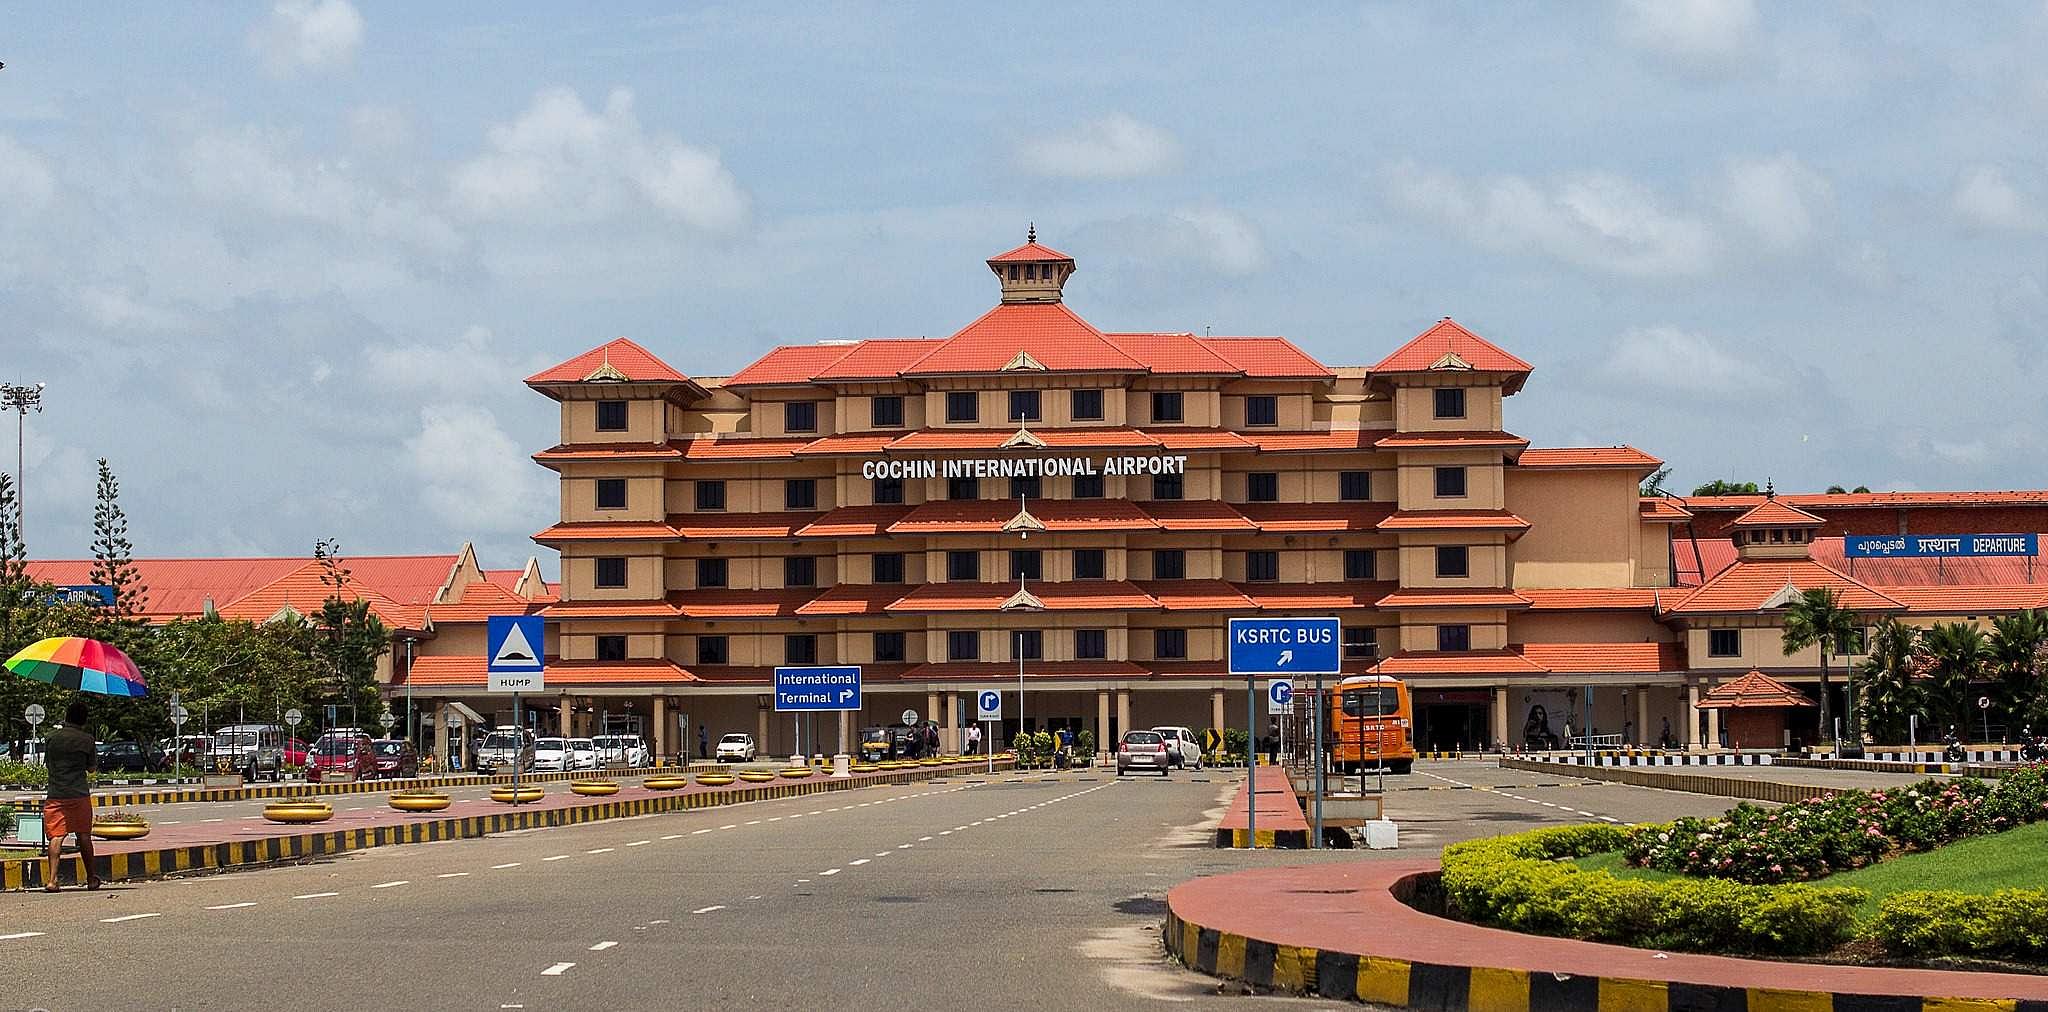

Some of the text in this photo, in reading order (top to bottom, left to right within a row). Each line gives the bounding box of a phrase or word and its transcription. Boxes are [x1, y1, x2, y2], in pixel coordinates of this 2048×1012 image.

[862, 455, 1187, 479] COCHIN INTERNATIONAL AIRPORT
[1918, 538, 1960, 553] प्रस्थान
[1973, 537, 2026, 553] DEPARTURE
[1237, 628, 1332, 644] KSRTC BUS
[500, 679, 531, 687] HUMP
[779, 673, 857, 685] International
[779, 692, 832, 703] Terminal
